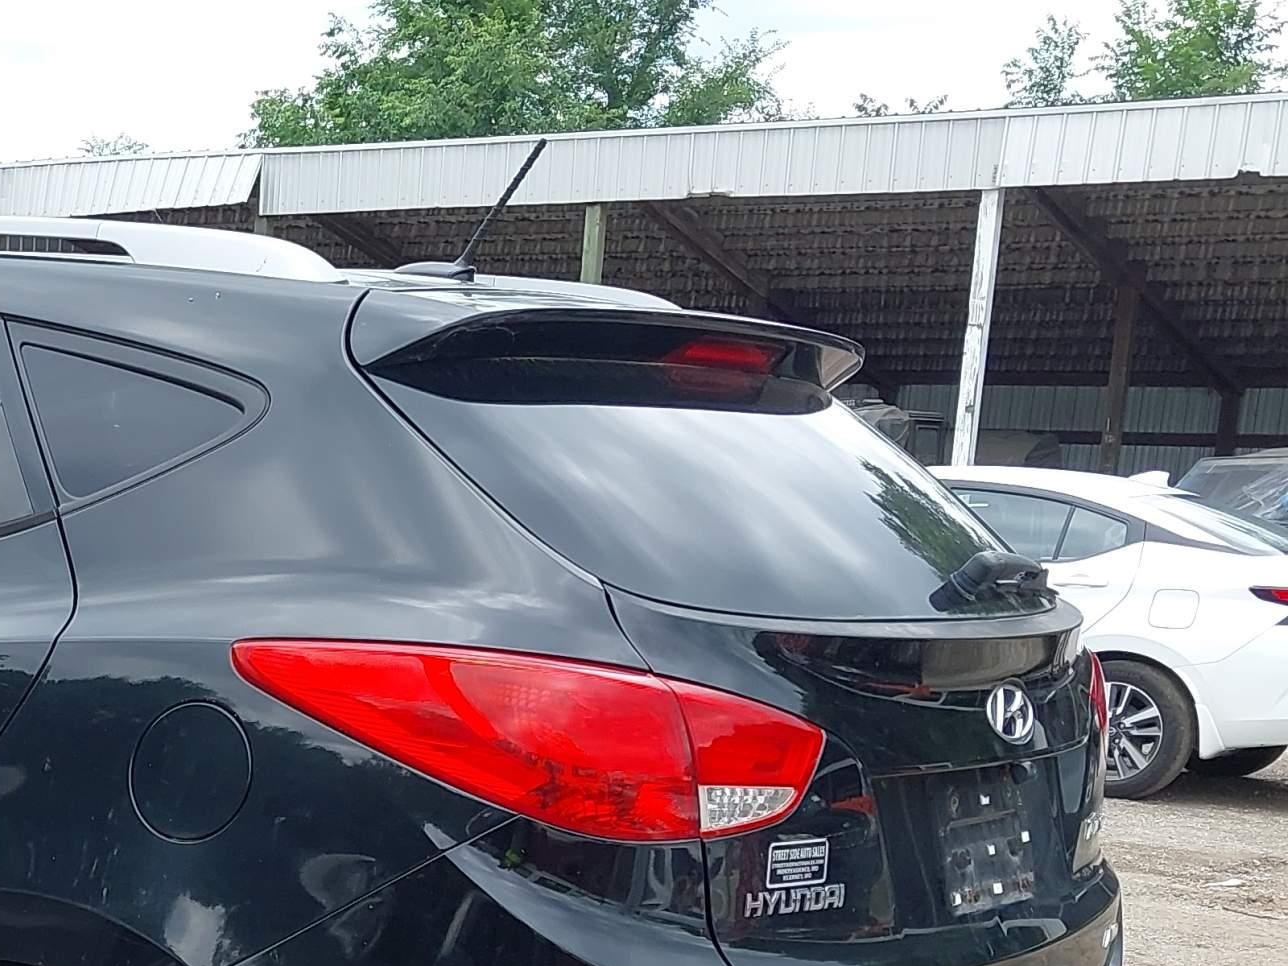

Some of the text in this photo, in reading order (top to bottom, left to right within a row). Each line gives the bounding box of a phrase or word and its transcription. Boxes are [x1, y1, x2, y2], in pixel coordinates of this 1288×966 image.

[772, 849, 789, 862] STREET
[811, 845, 825, 858] SALES
[744, 883, 845, 918] HYUNDAI
